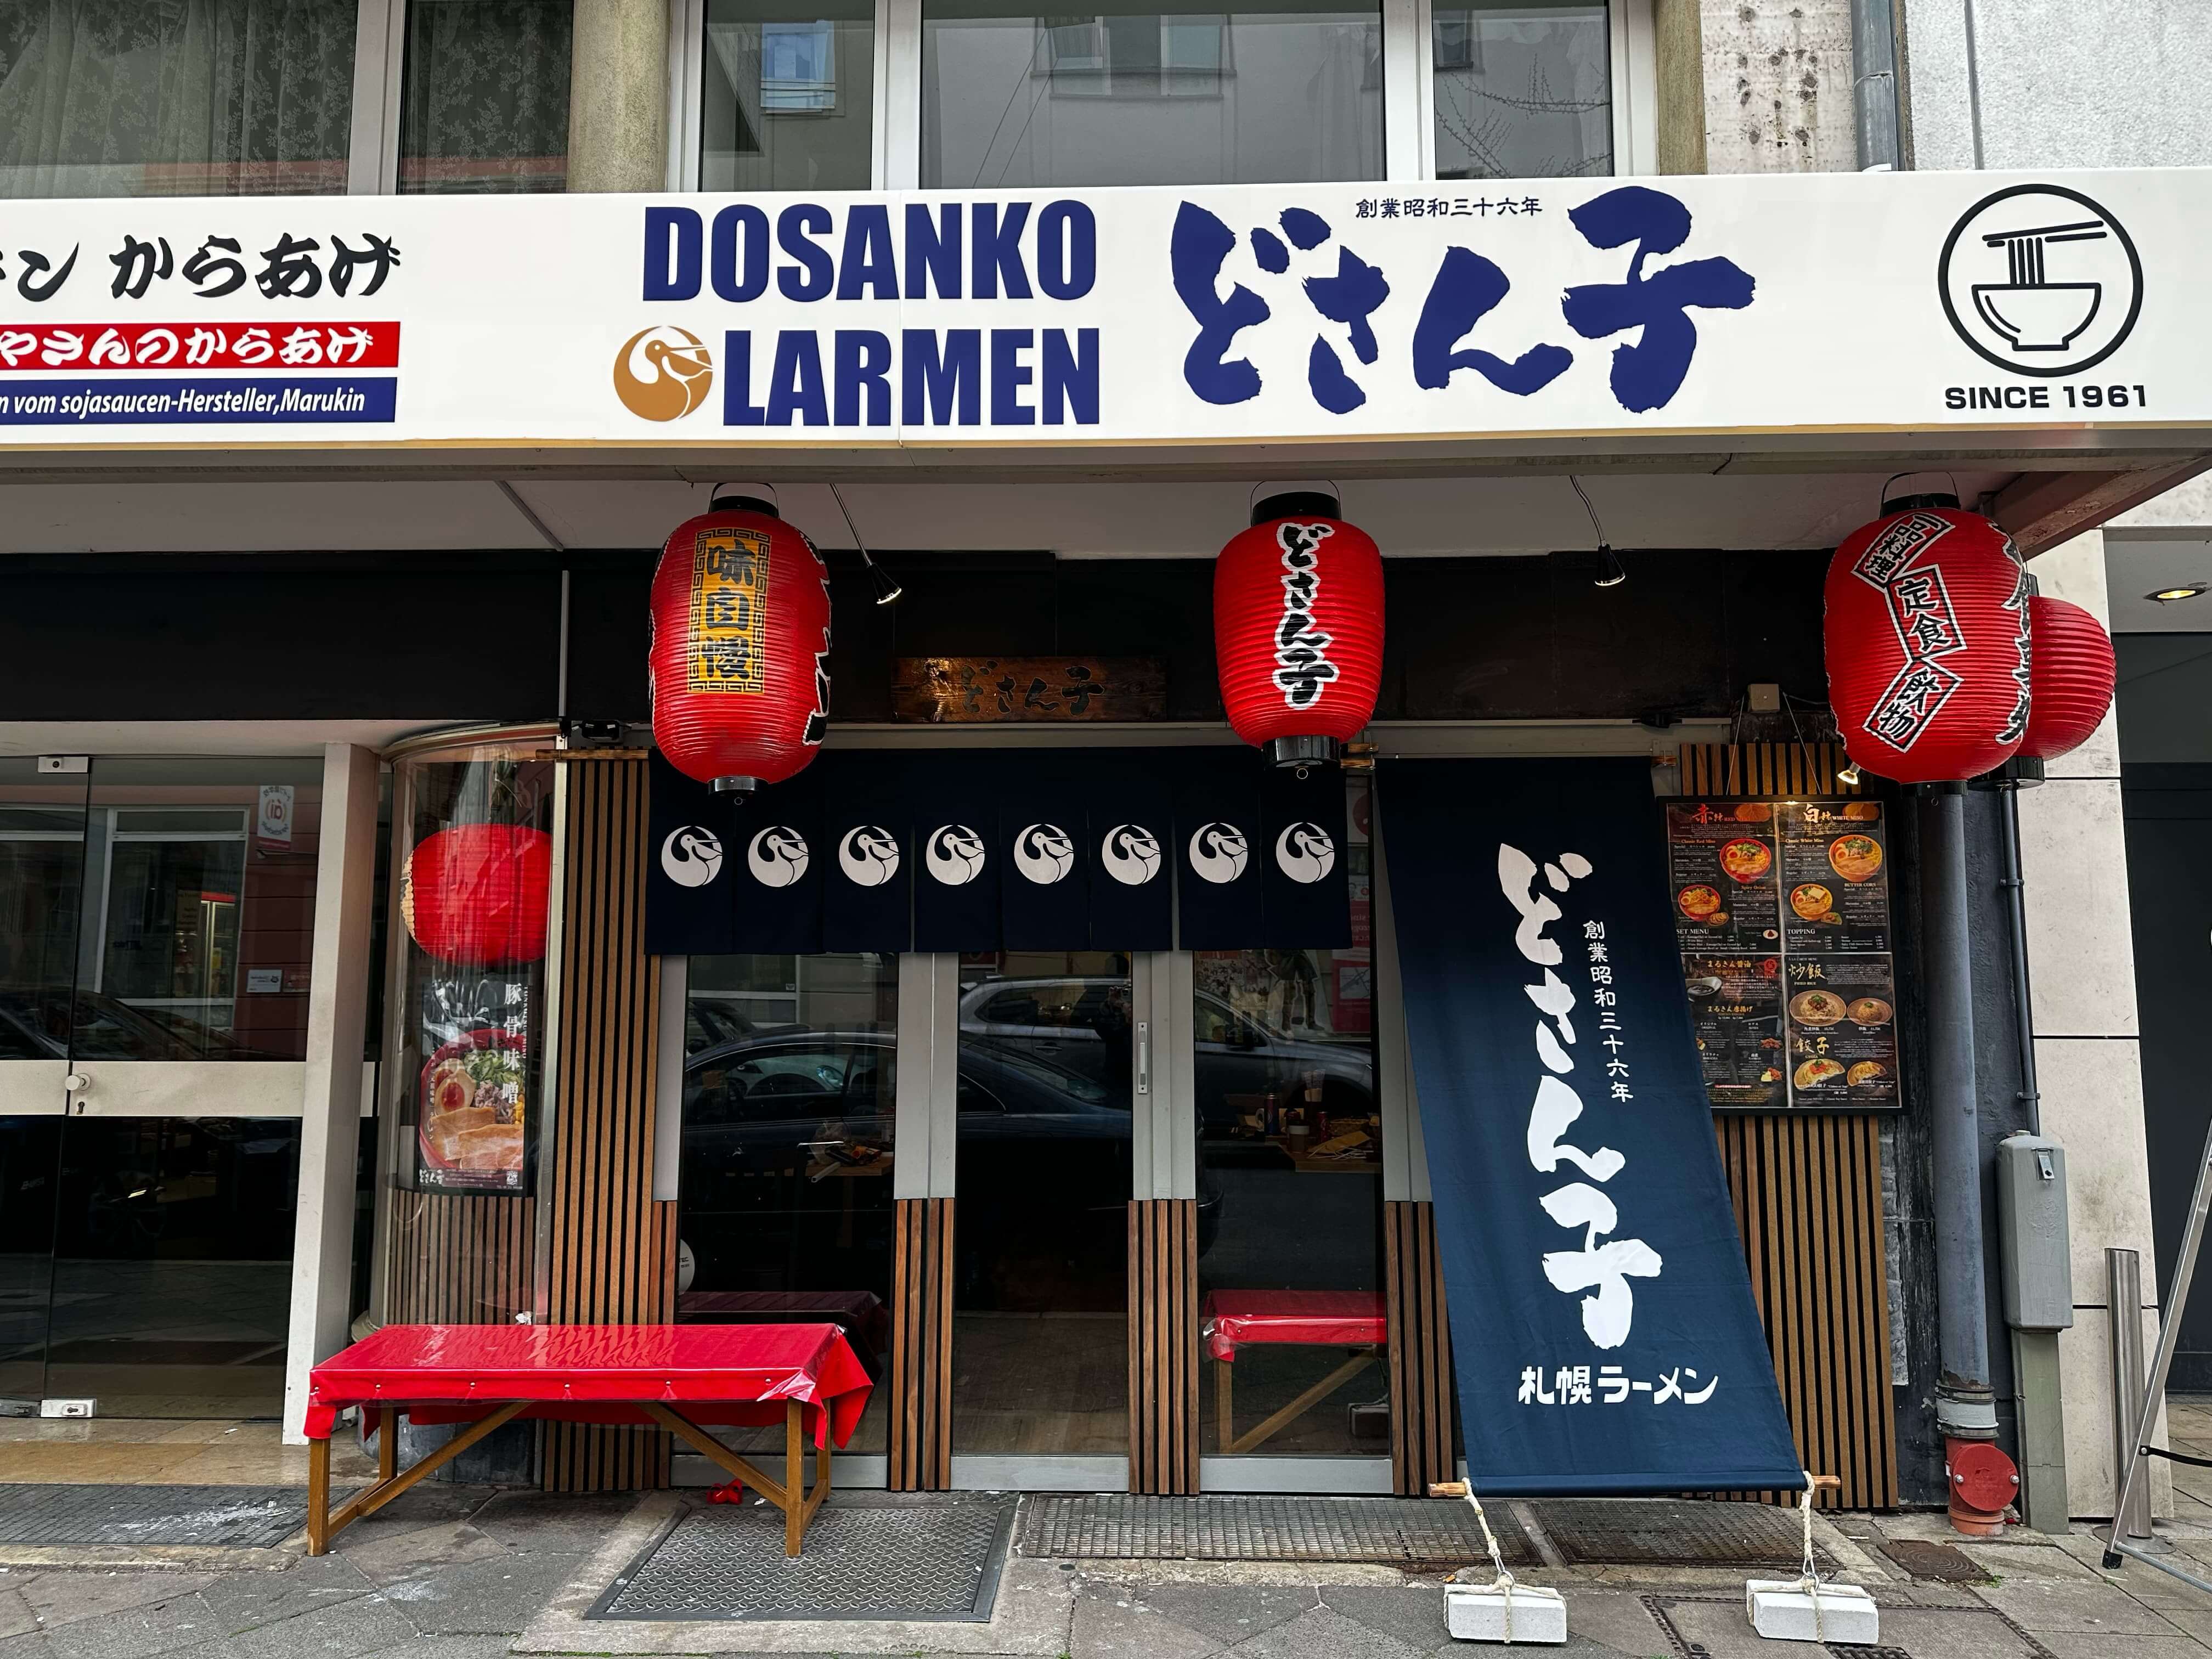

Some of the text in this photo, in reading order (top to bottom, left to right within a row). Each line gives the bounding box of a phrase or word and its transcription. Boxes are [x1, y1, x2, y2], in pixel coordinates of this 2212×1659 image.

[1356, 196, 1543, 218] 創業昭和三十六年
[109, 232, 401, 300] からあげ
[643, 200, 1096, 303] DOSANKO
[1170, 185, 1756, 415] どさん子
[14, 396, 56, 414] vom
[60, 387, 365, 420] sojasaucen-Hersteller,Marukin
[724, 328, 1099, 426] LARMEN
[1945, 385, 2146, 410] SINCE 1961
[1865, 513, 1942, 583] 一品料理
[1273, 523, 1340, 710] どさん子
[1894, 576, 1953, 653] 定食
[960, 659, 1105, 716] どさん子
[1877, 666, 1943, 740] 飲物
[1788, 962, 1826, 980] 炒飯
[501, 983, 523, 1105] 豚骨味噌
[1583, 920, 1634, 1103] 創業昭和三十六年
[1796, 1036, 1830, 1055] 餃子
[1498, 843, 1663, 1350] どさん子
[1518, 1365, 1718, 1405] 札幌ラーメン
